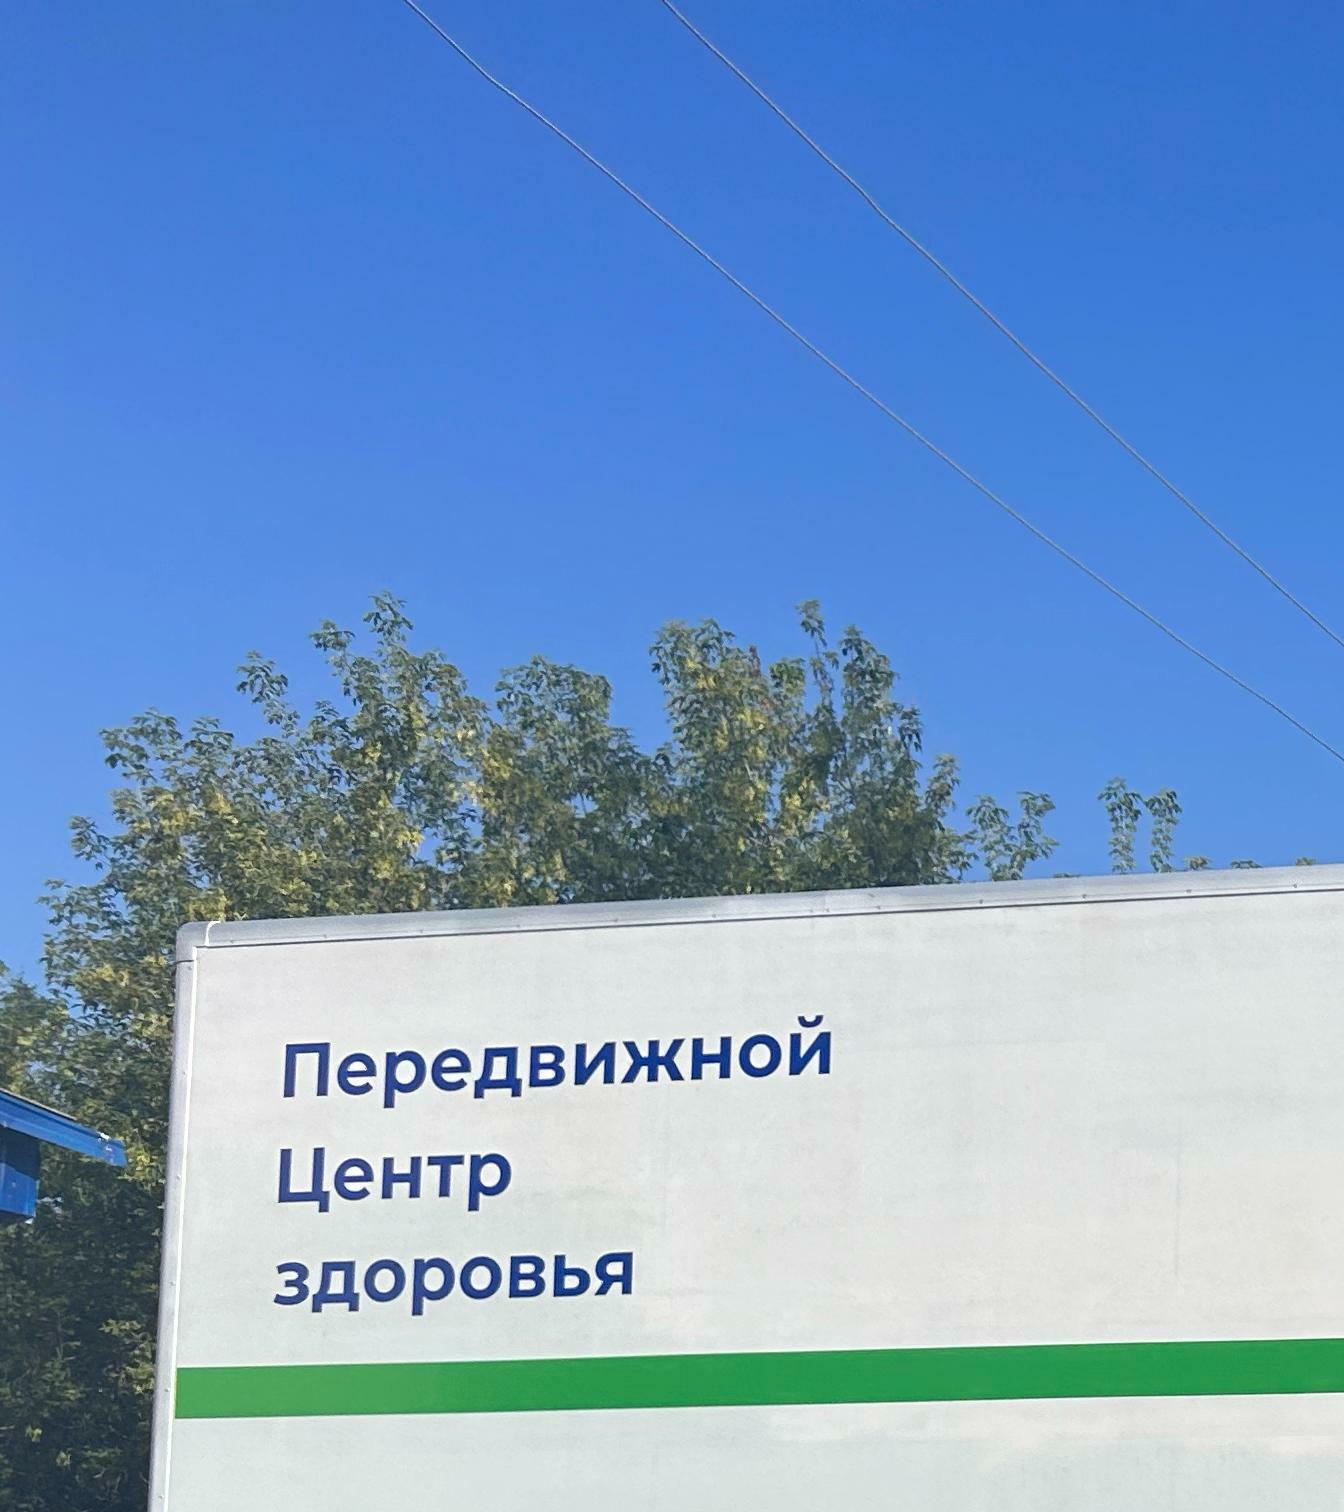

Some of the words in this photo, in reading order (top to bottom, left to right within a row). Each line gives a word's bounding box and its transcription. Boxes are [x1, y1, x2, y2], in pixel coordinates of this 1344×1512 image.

[283, 1014, 832, 1109] Передвижной
[277, 1147, 512, 1212] Центр
[273, 1251, 633, 1317] здоровья
